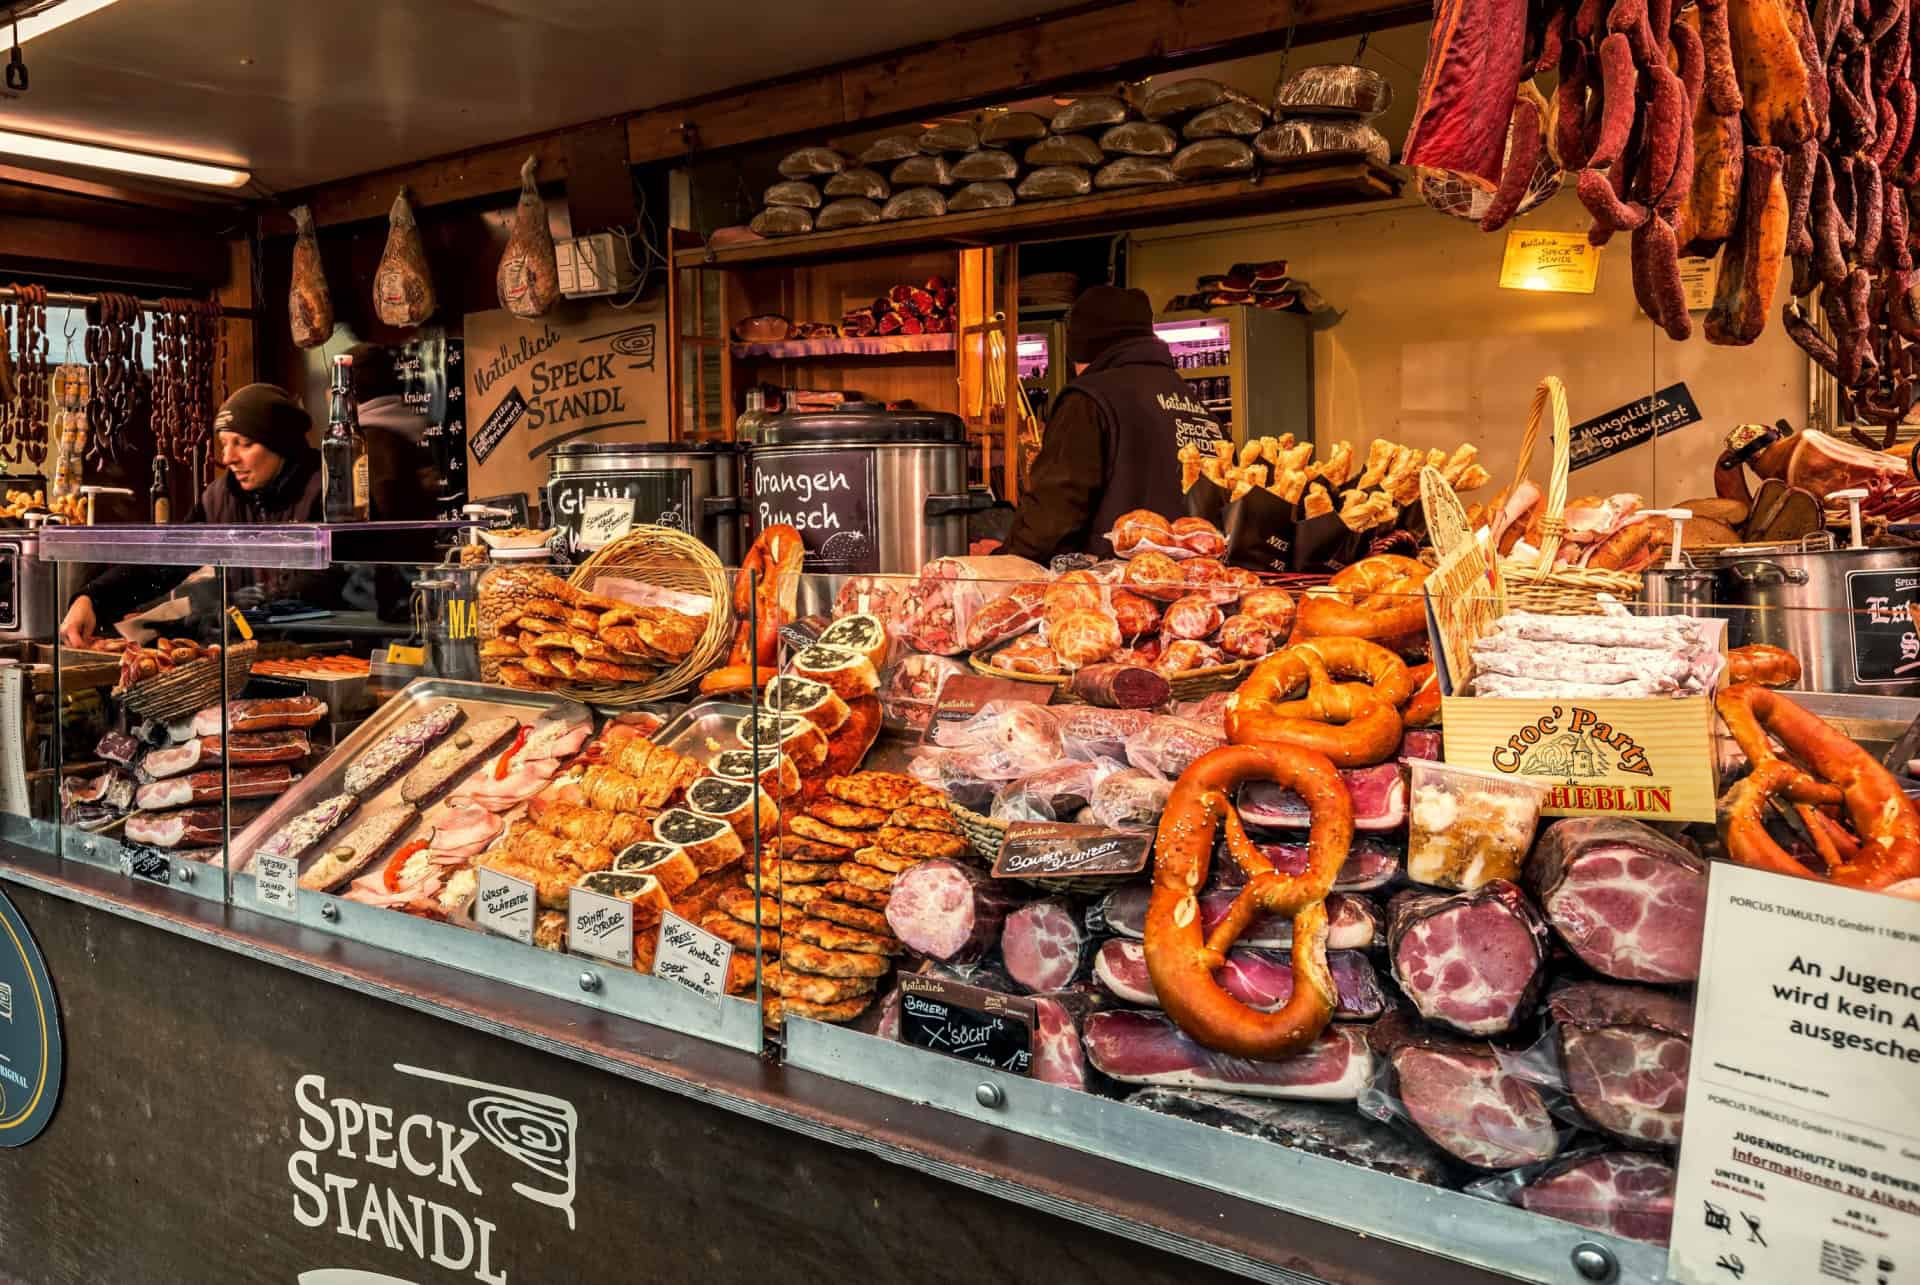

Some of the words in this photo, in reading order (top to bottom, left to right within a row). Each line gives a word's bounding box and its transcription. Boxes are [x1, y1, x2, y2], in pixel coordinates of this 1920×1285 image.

[473, 324, 560, 396] Natürlich
[530, 352, 616, 394] SPECK
[527, 386, 625, 430] STANDL
[1600, 404, 1689, 449] Bratwurst
[755, 466, 850, 502] Orangen
[759, 502, 840, 534] Punsch
[1492, 705, 1563, 774] Croc'
[1568, 707, 1654, 777] Party
[592, 913, 625, 937] STRUDEL
[1729, 895, 1774, 913] PORCUS
[1775, 905, 1836, 927] TUMULTUS
[1837, 918, 1876, 935] GmbH
[1788, 955, 1822, 978] An
[1772, 984, 1829, 1010] wird
[1837, 996, 1893, 1025] kein
[295, 1074, 483, 1196] SPECK
[1732, 1131, 1836, 1170] JUGENDSCHUTZ
[1838, 1161, 1868, 1178] UND
[1715, 1168, 1751, 1184] UNTER
[1732, 1147, 1842, 1190] Informationen
[1847, 1183, 1866, 1198] zu
[288, 1150, 507, 1285] STANDL
